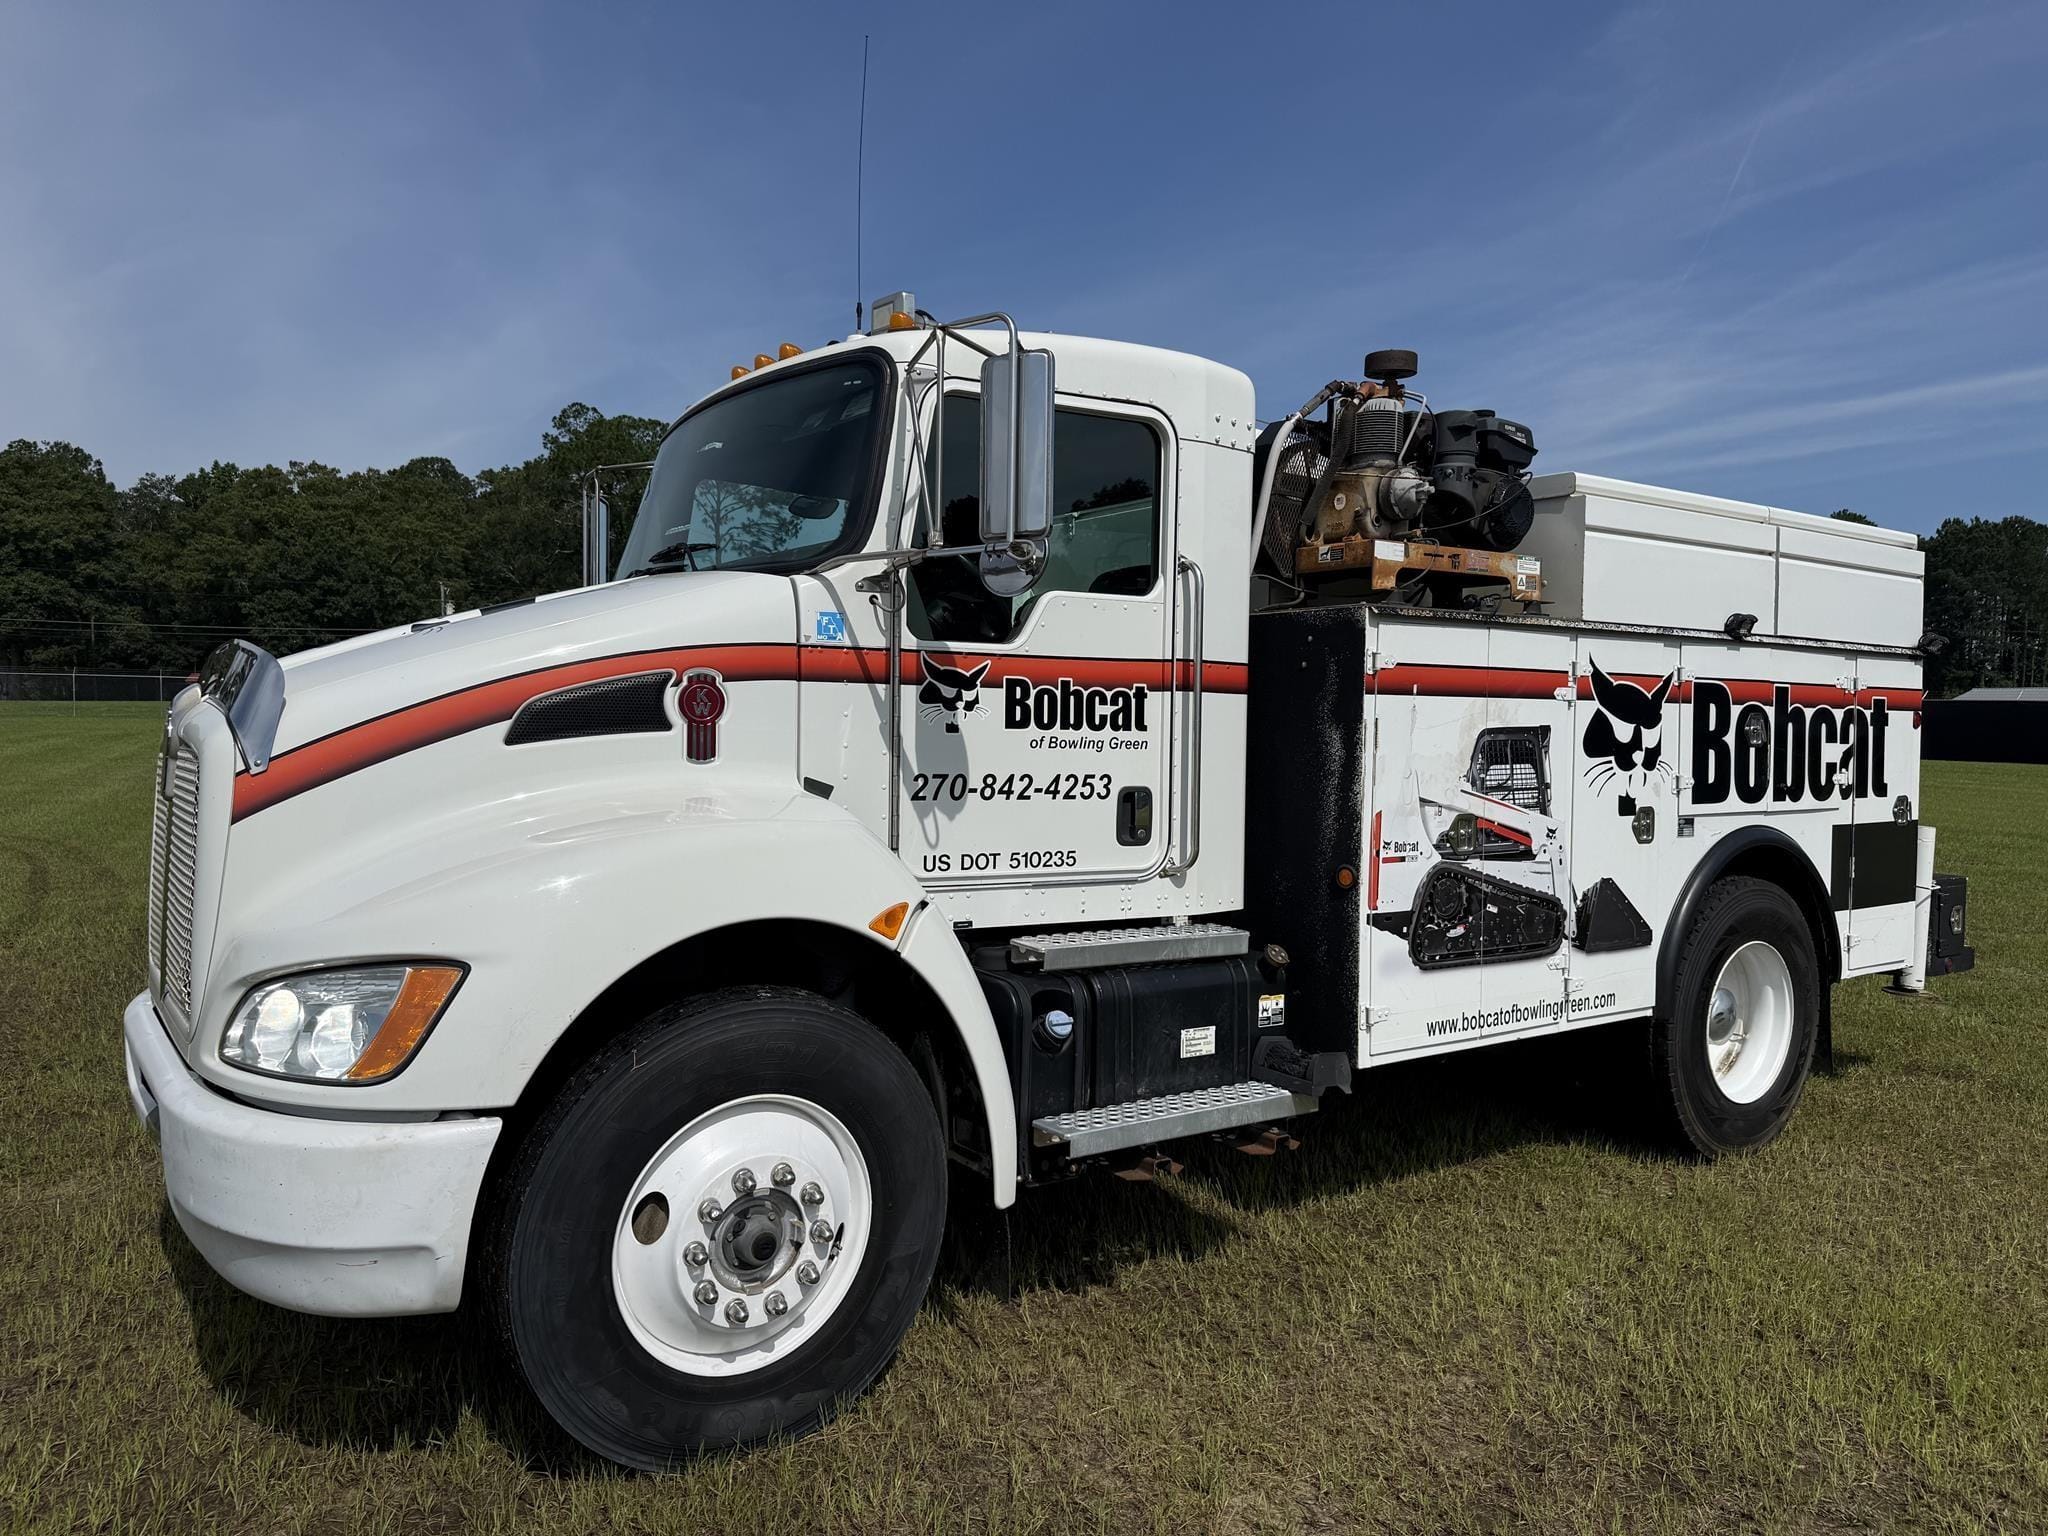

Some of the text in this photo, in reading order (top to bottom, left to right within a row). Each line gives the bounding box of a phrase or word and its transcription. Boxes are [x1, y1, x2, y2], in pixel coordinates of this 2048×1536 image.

[1003, 676, 1149, 732] Bobcat
[1029, 735, 1149, 753] of Bowling Green
[1691, 680, 1889, 805] Bobcat
[910, 772, 1113, 802] 270-842-4253
[923, 850, 1078, 873] US DOT 510235
